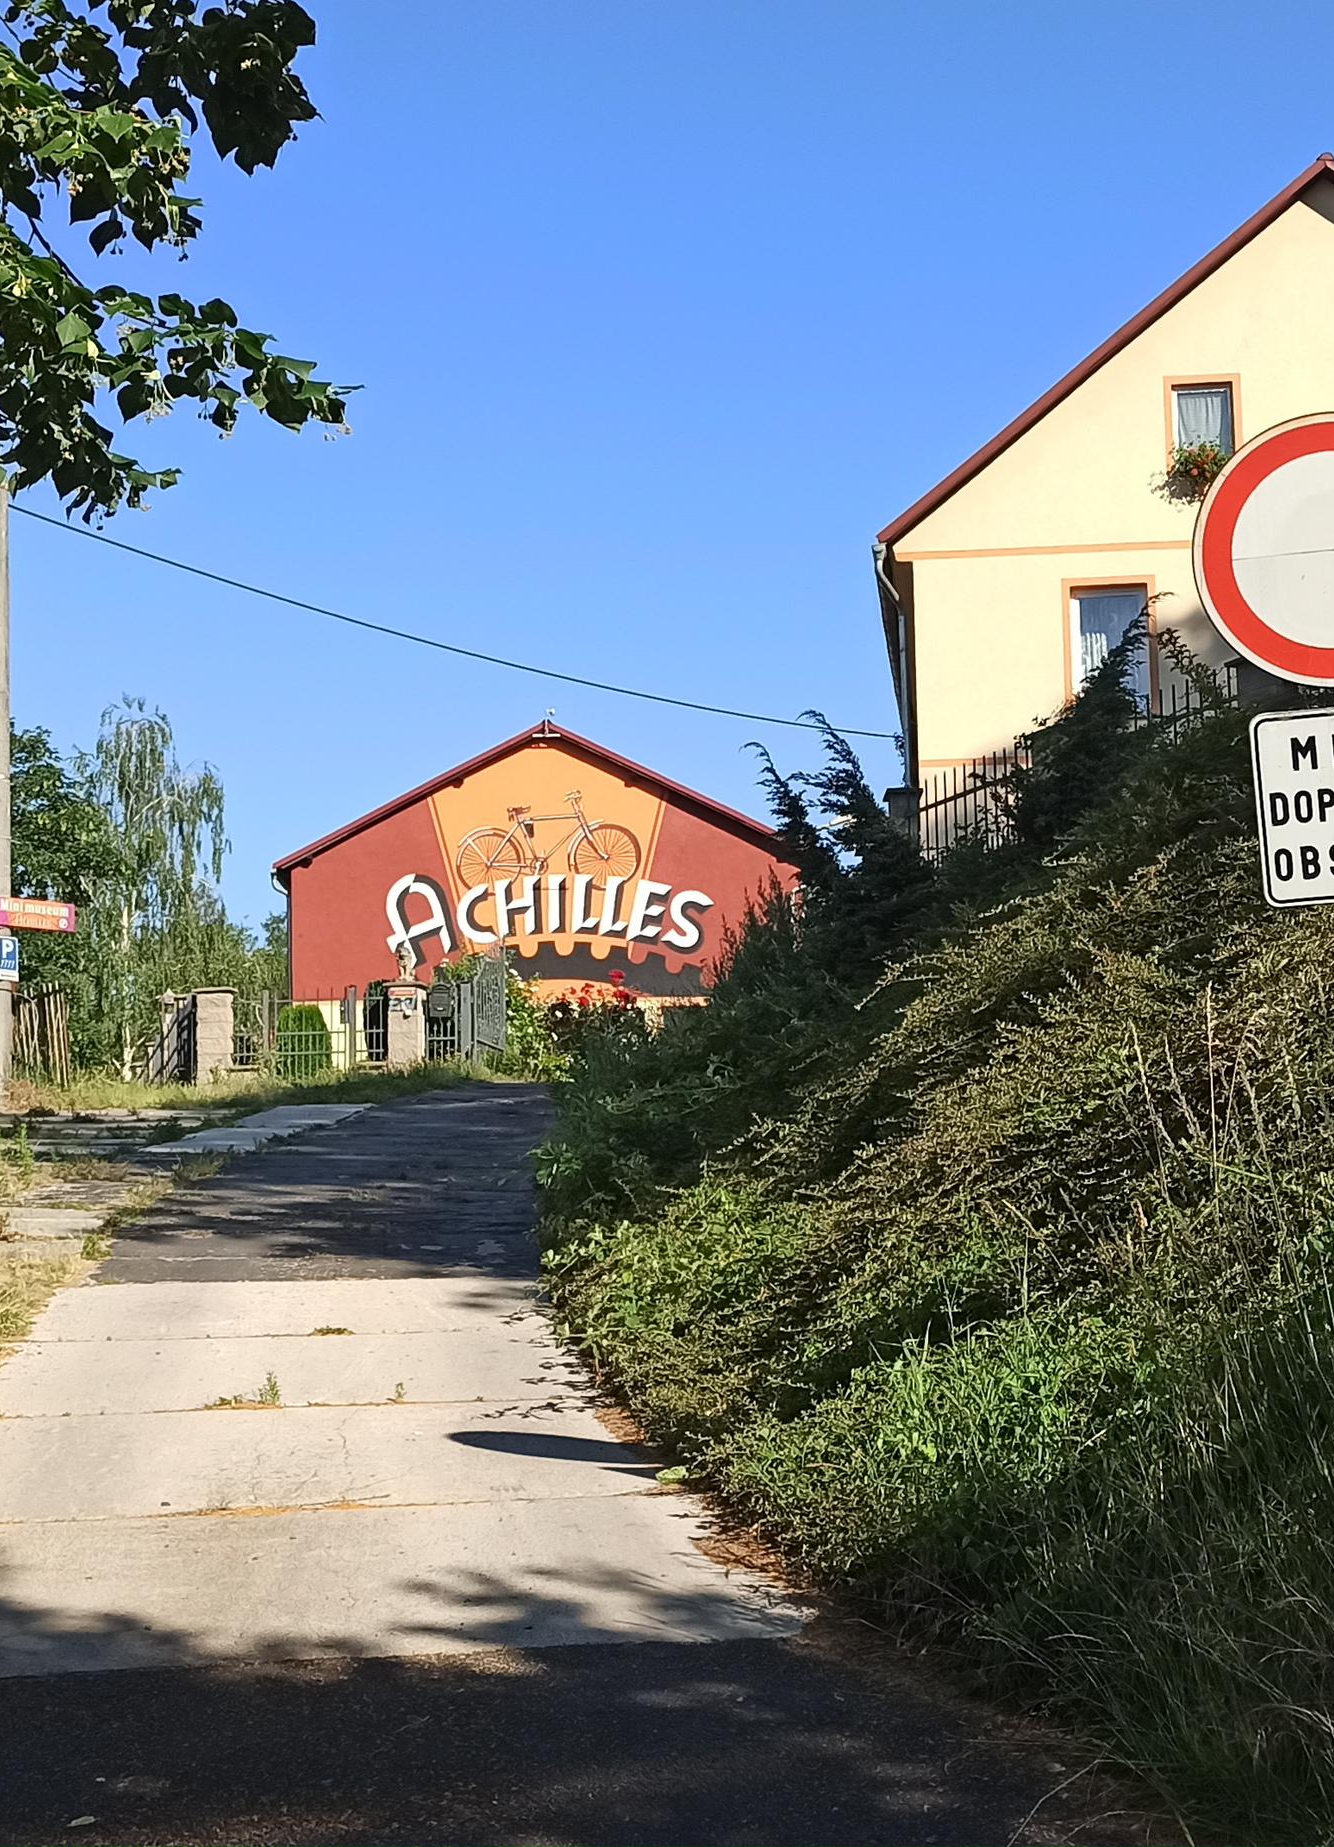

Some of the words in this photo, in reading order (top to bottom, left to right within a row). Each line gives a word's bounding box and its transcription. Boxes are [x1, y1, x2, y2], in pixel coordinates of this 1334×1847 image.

[0, 897, 23, 913] Mini
[24, 902, 69, 918] museum
[385, 872, 716, 971] ACHILLES
[2, 938, 14, 959] P
